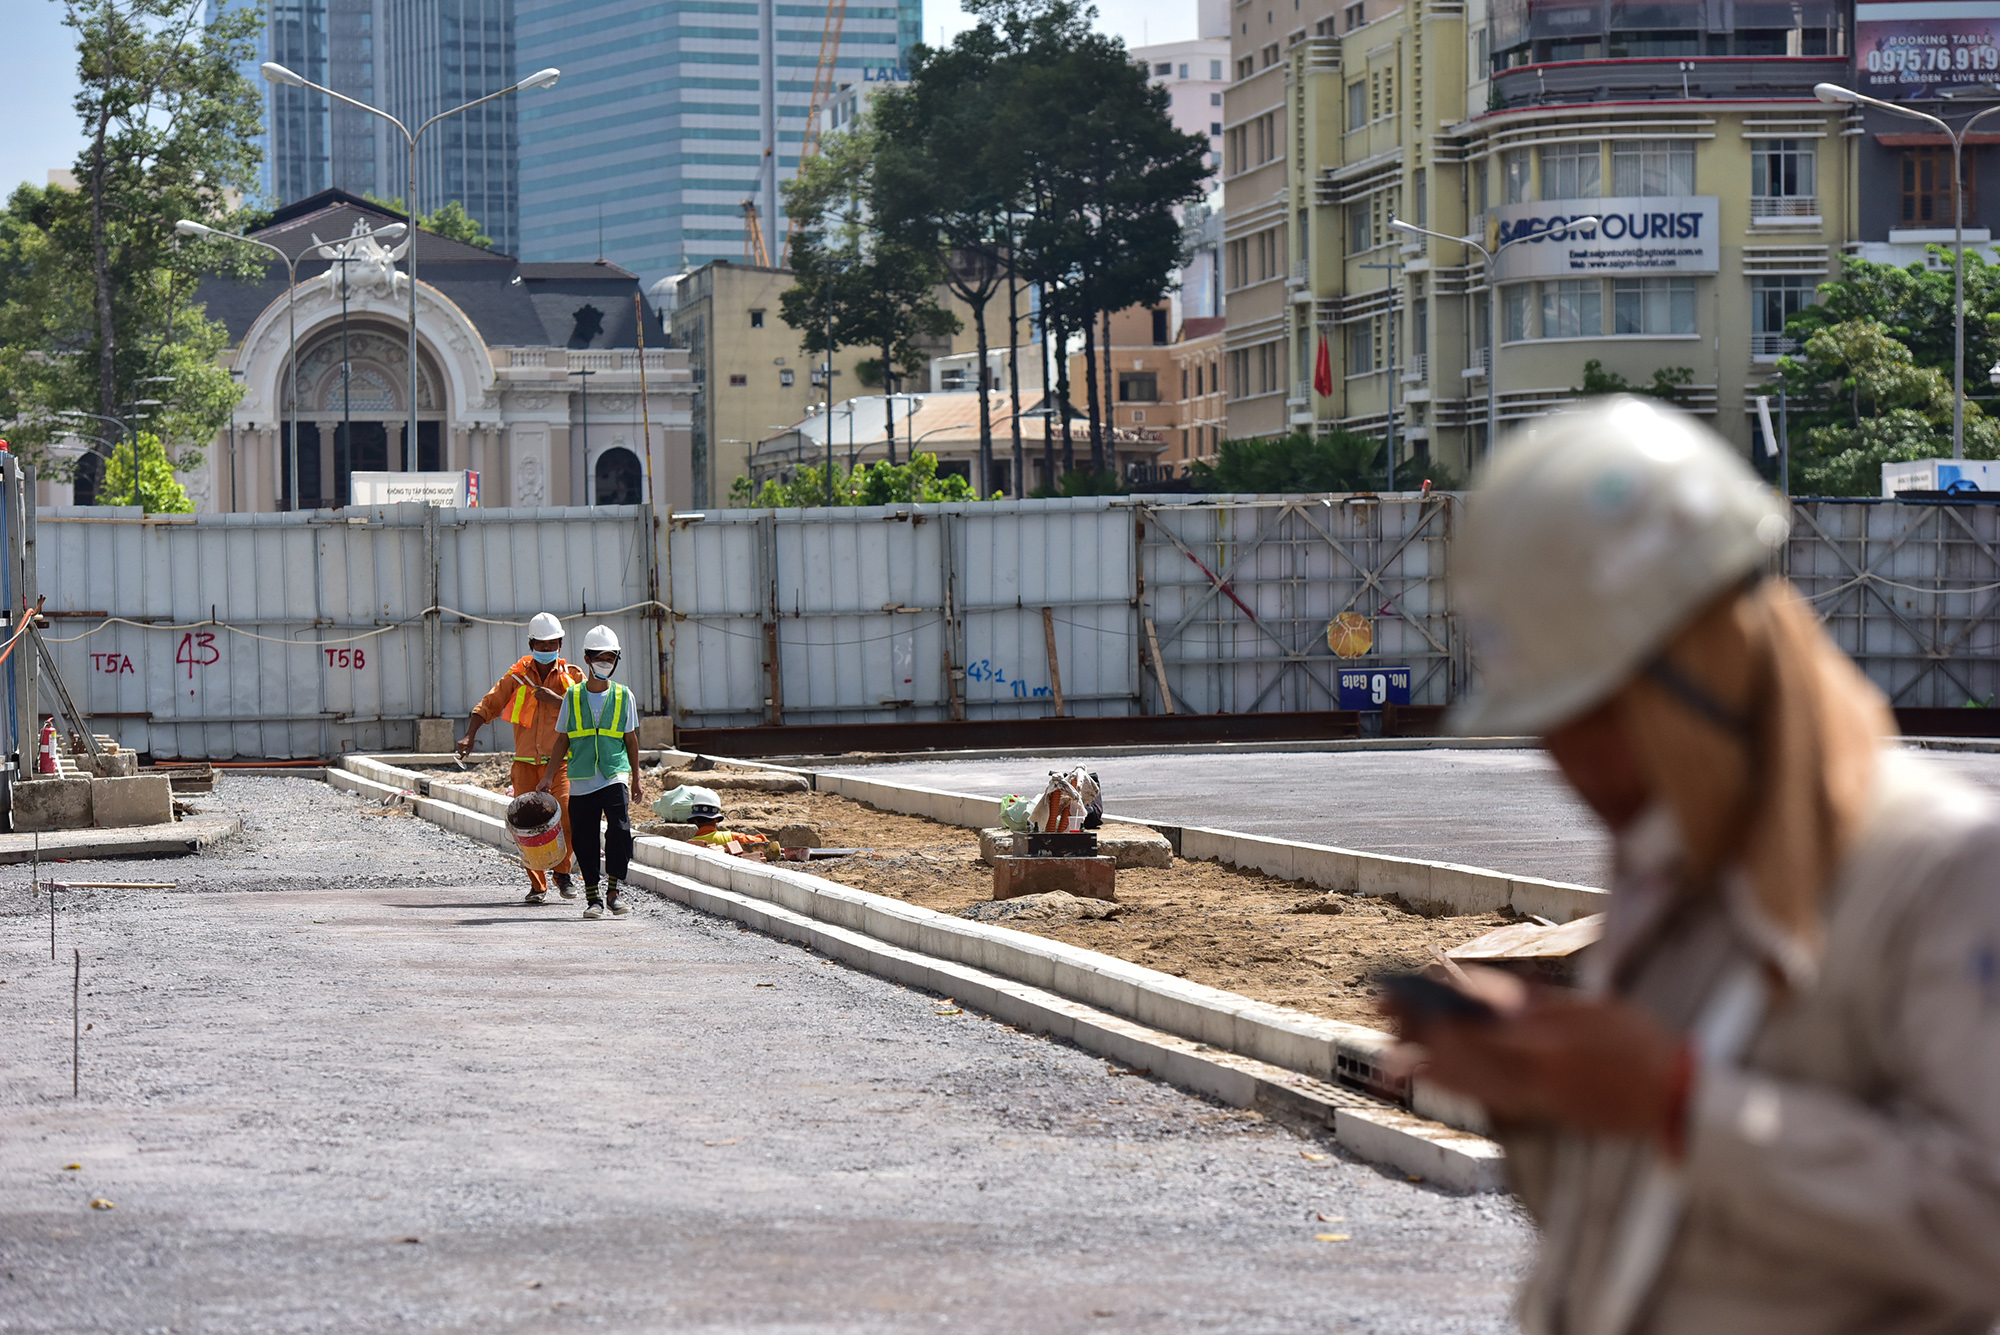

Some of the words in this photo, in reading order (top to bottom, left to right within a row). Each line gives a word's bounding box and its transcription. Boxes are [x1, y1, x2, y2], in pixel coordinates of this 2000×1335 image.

[1889, 34, 1948, 46] BOOKING
[1951, 34, 1991, 45] TABLE
[1870, 74, 1896, 85] BEER
[1900, 73, 1942, 84] GARDEN
[1952, 73, 1976, 83] LIVE
[90, 653, 135, 674] T5A
[176, 632, 220, 680] 43
[324, 648, 366, 670] T5B
[1342, 674, 1368, 690] Gate
[1371, 673, 1387, 705] 6
[1388, 673, 1408, 689] No.
